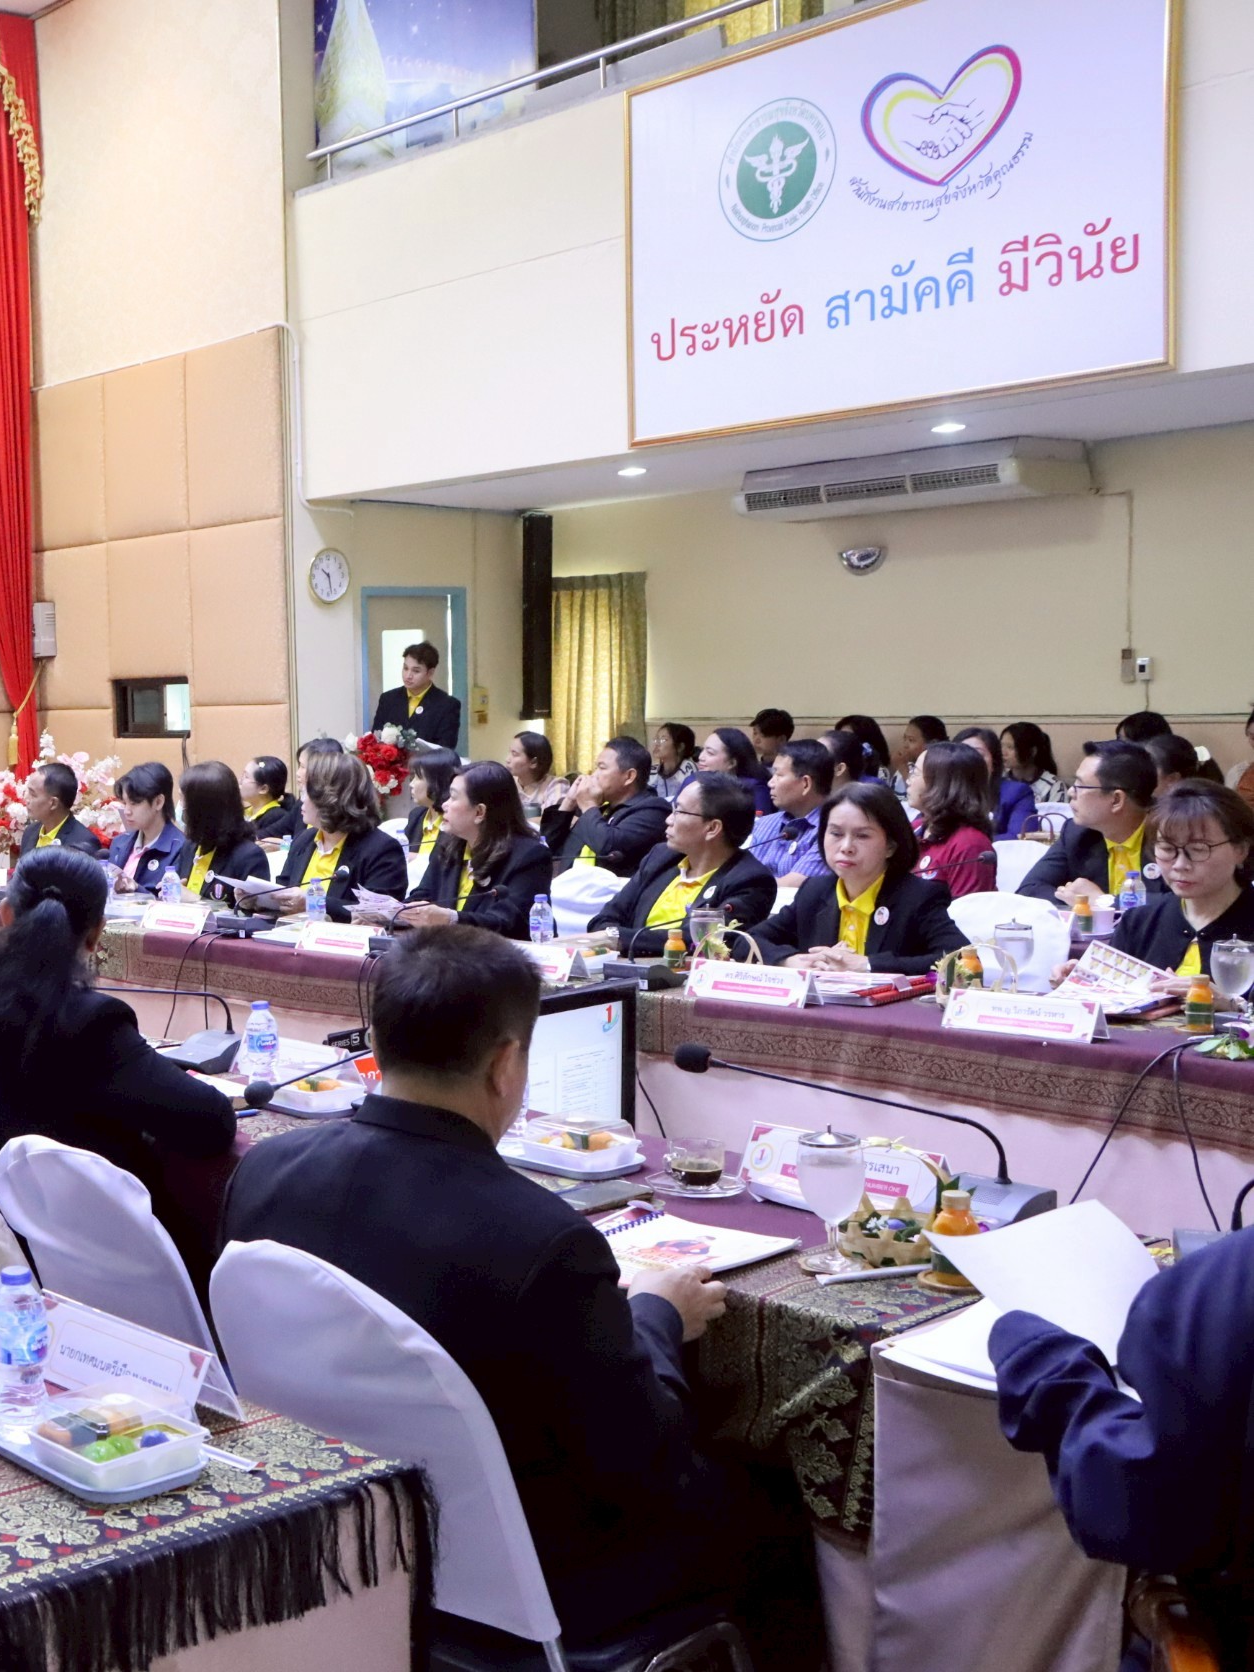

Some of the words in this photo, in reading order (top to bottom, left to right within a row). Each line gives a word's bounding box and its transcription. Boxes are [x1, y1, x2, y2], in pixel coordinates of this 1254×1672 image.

[650, 288, 805, 362] ประหยัด
[825, 247, 975, 329] สามัคคี
[998, 217, 1140, 296] มีวินัย
